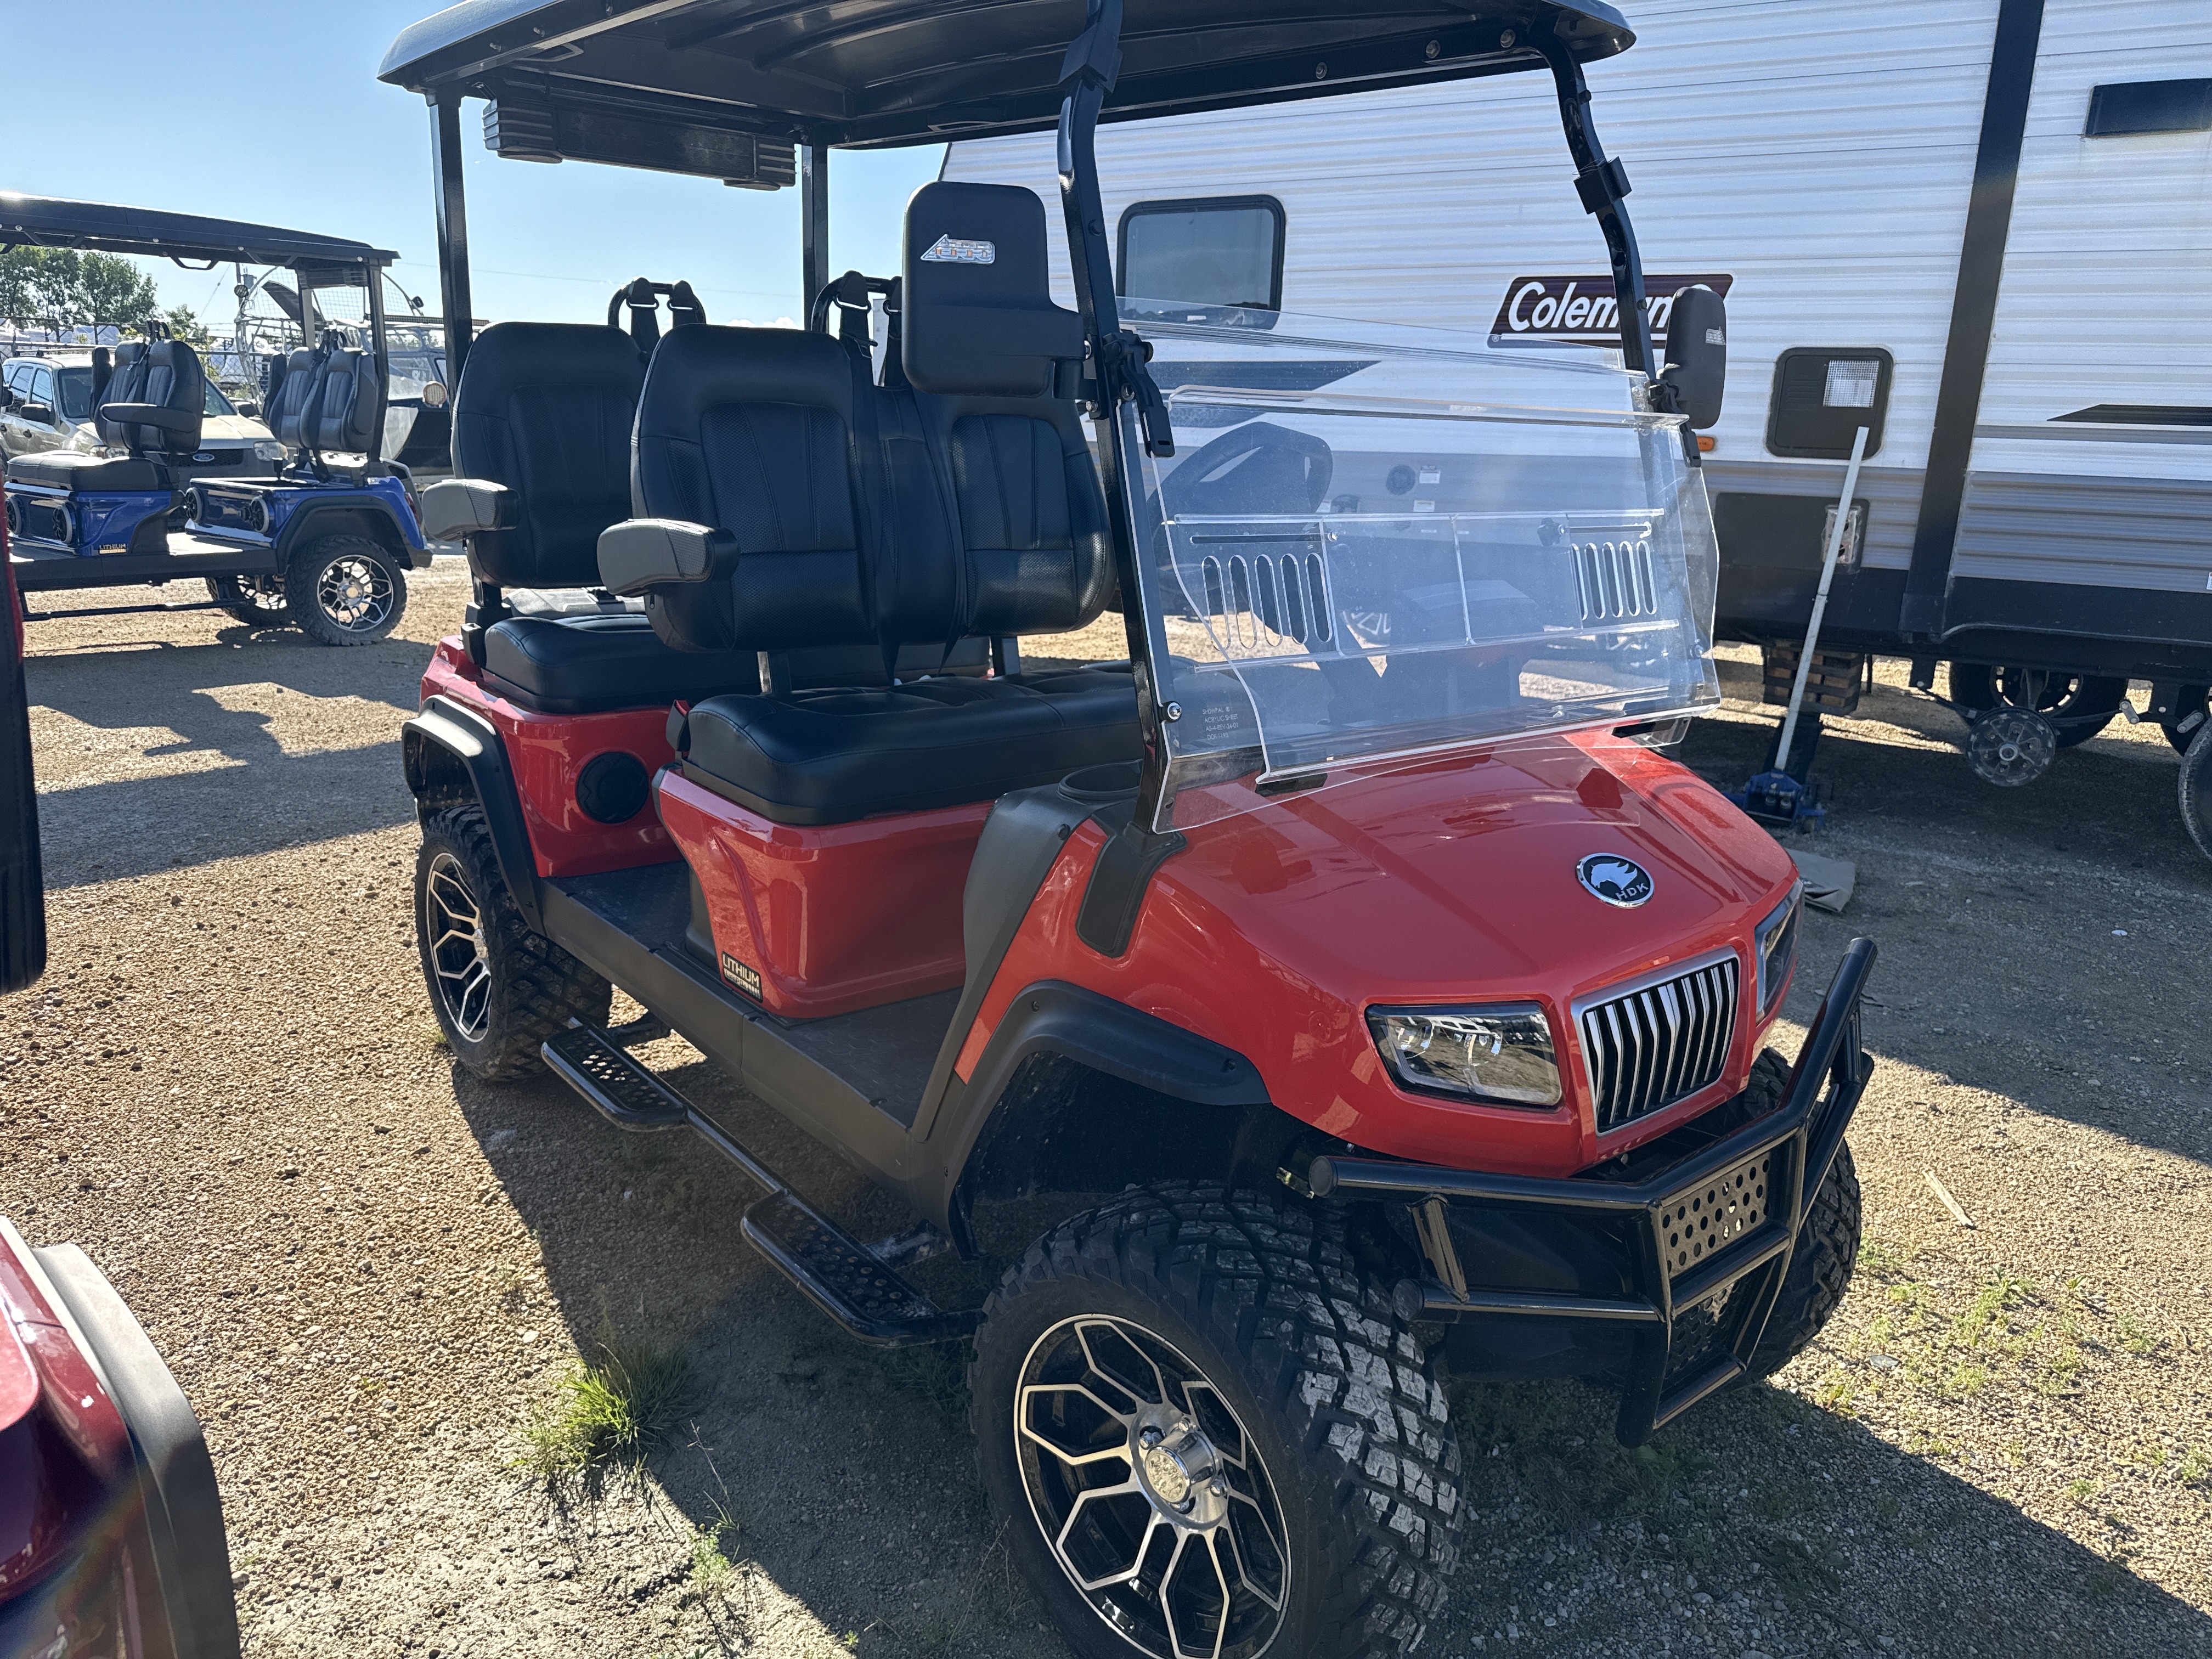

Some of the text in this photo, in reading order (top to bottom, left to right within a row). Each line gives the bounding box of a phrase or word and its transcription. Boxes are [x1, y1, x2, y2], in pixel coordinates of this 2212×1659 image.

[1508, 282, 1673, 331] Colemn
[1204, 715, 1224, 723] ACRYLIC
[1615, 883, 1649, 900] HDK
[723, 953, 759, 988] LITHIUM
